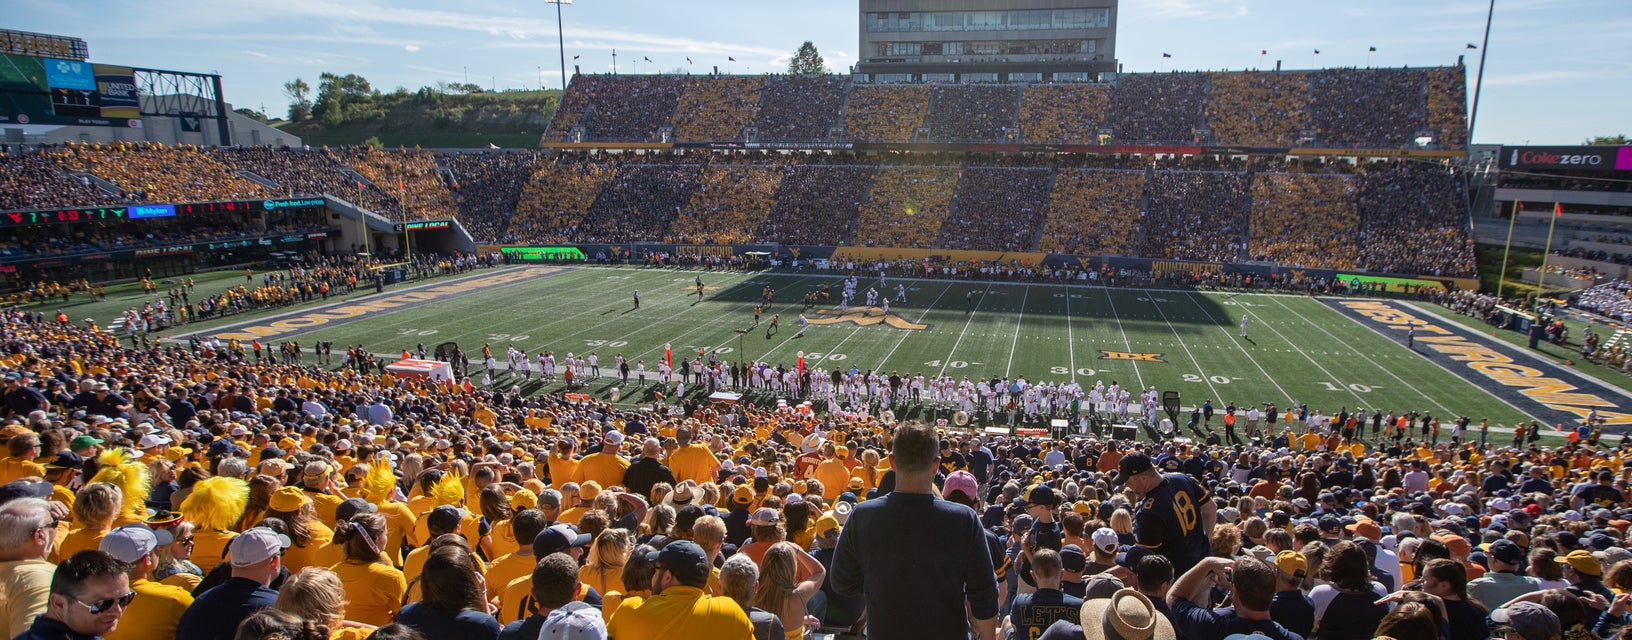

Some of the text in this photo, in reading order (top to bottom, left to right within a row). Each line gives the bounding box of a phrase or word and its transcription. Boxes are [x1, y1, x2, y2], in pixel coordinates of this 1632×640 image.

[106, 82, 135, 91] UNITED
[108, 89, 130, 97] BANK
[145, 207, 168, 215] Mylan
[423, 221, 449, 230] LOCAL
[161, 245, 193, 255] LOCAL
[675, 245, 733, 259] WEST VIRGINIA
[1151, 260, 1224, 274] MOUNTAINEERS
[212, 267, 562, 341] MOUNTAINEERS
[1340, 301, 1454, 335] WEST
[804, 352, 848, 361] 50
[924, 360, 969, 369] 40
[1050, 366, 1096, 376] 30
[1182, 373, 1231, 385] 20
[1413, 337, 1632, 425] VIRGINIA
[1317, 381, 1373, 393] 10
[1086, 457, 1093, 467] 8
[1172, 490, 1197, 538] 18
[1020, 604, 1081, 626] LET'S
